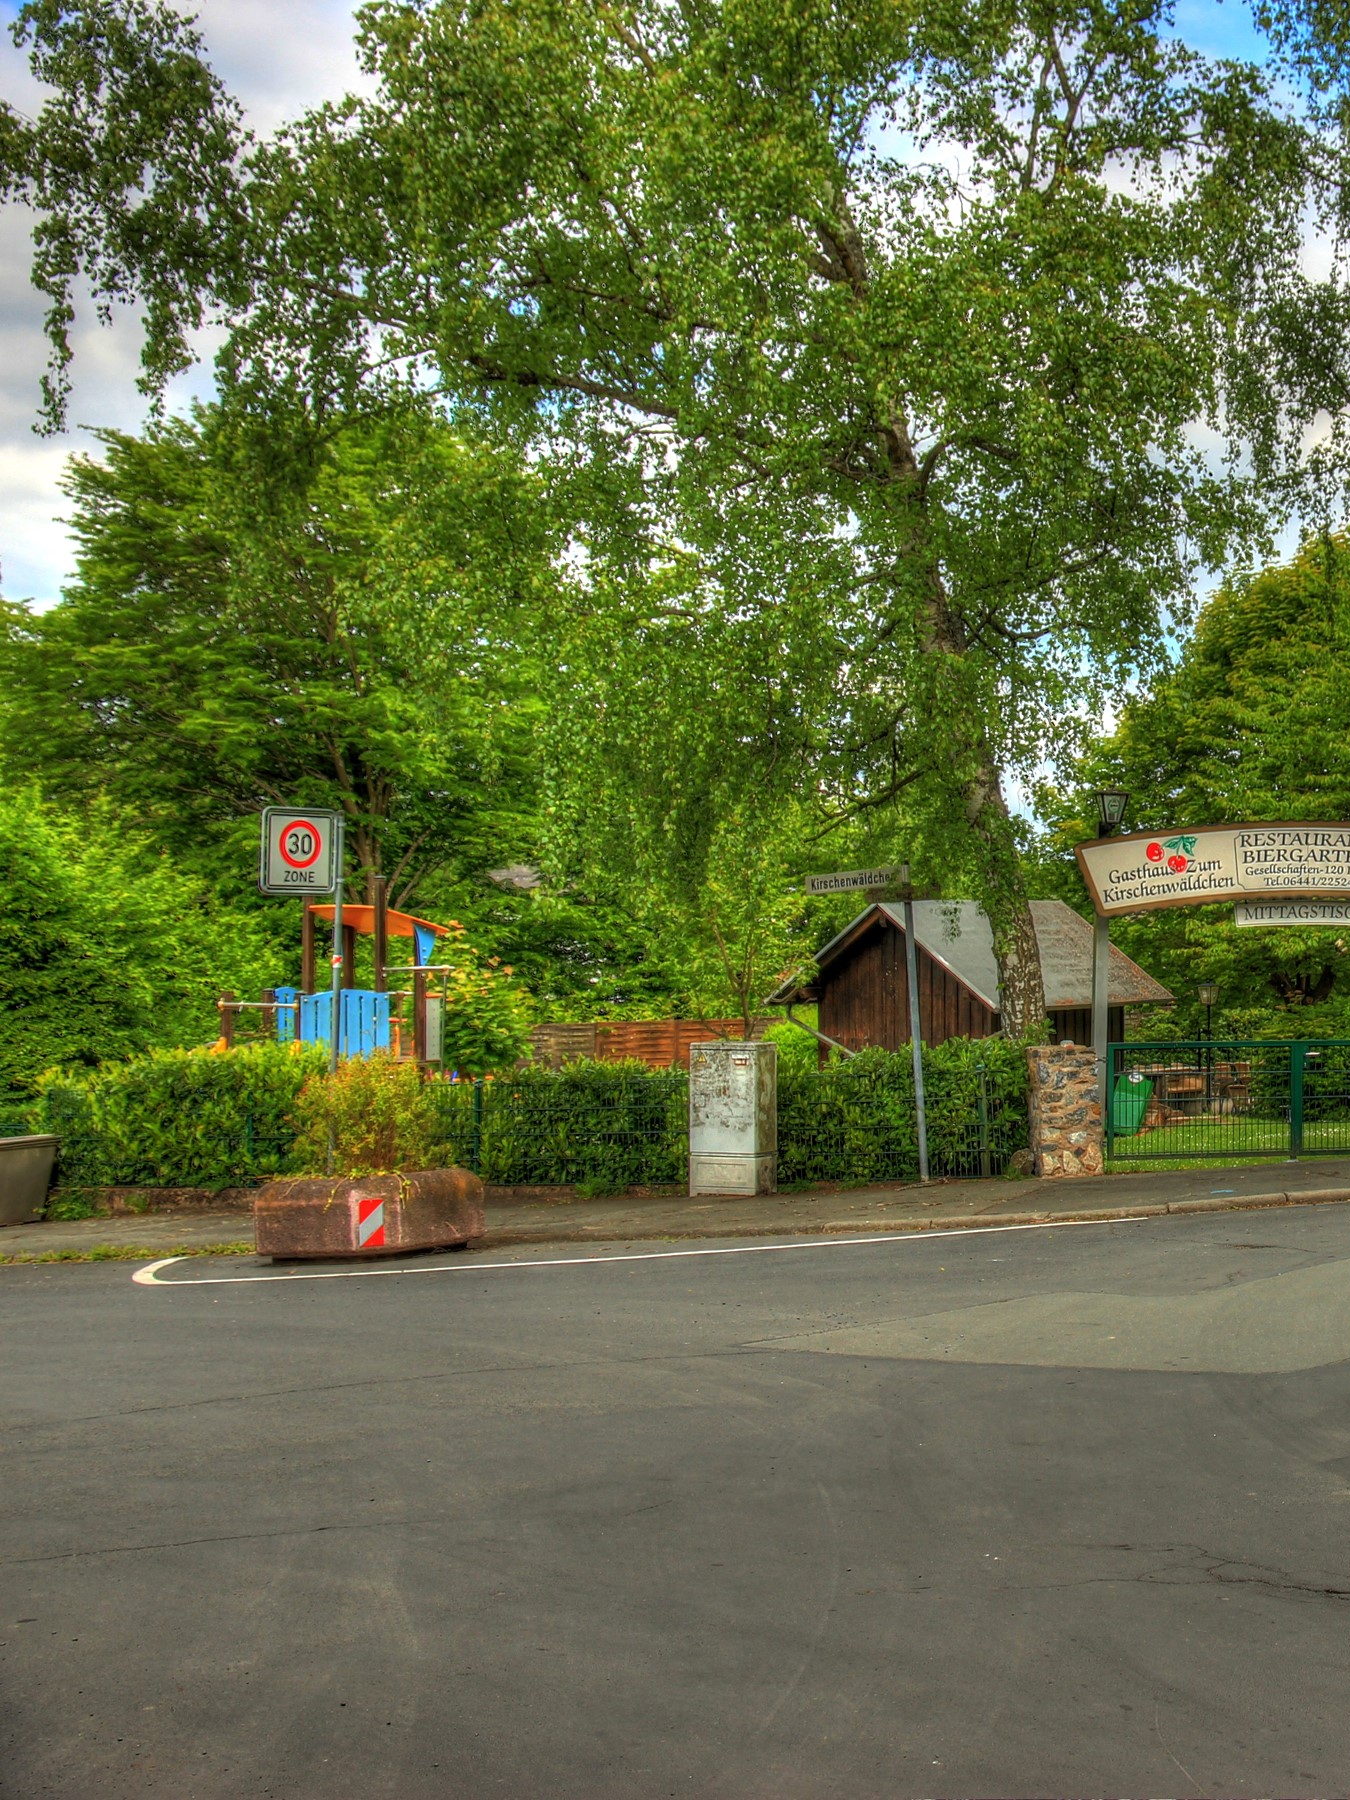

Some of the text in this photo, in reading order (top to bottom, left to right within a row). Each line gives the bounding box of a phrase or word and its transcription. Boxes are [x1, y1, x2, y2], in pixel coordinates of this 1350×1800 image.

[288, 833, 312, 855] 30
[284, 870, 315, 883] ZONE
[1108, 859, 1222, 884] Gasthaus Zum
[1102, 873, 1235, 903] Kirschenwäldchen
